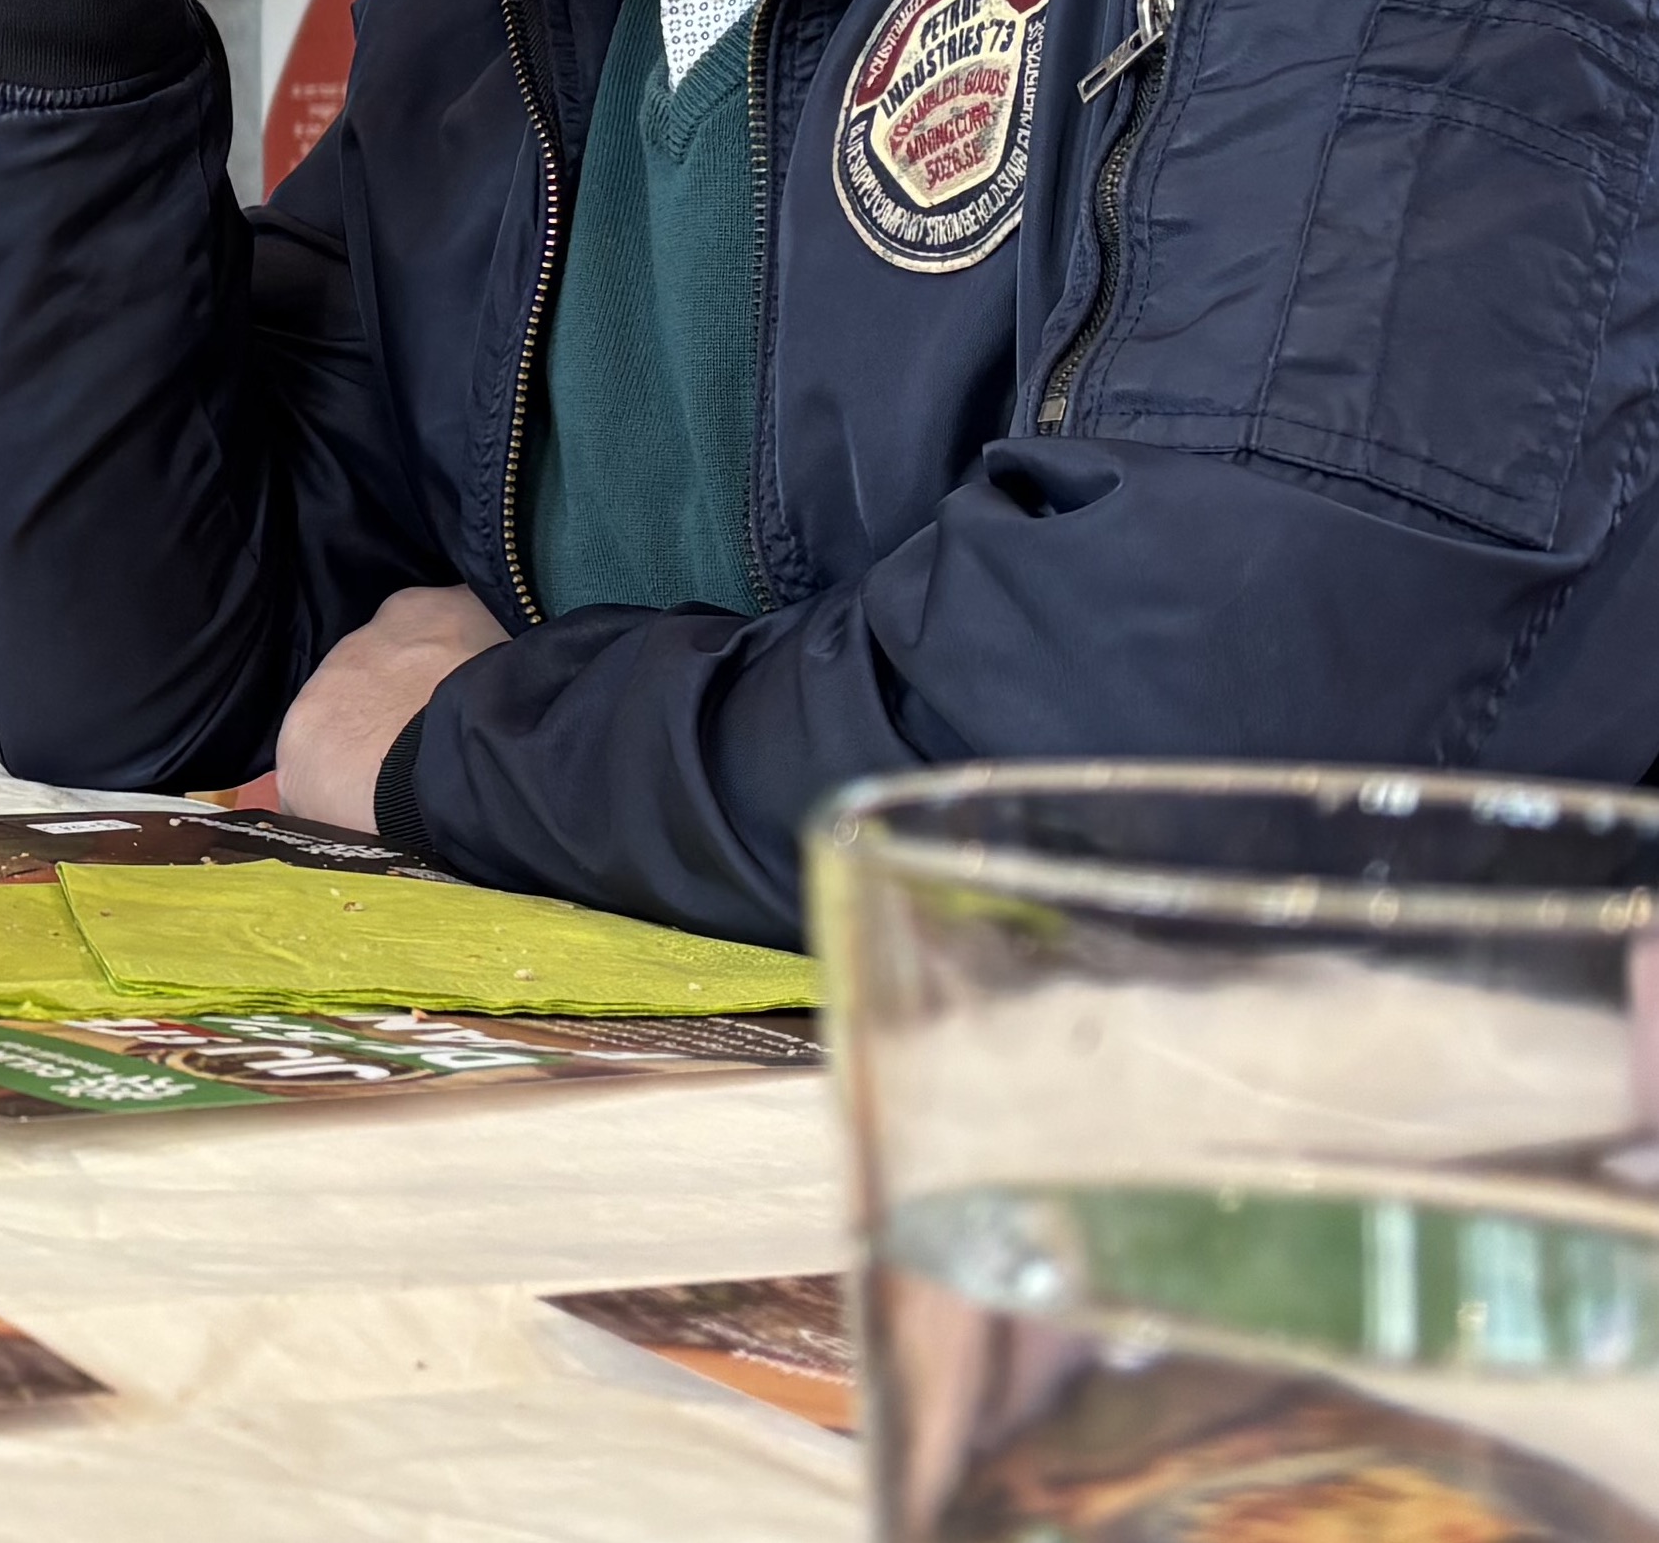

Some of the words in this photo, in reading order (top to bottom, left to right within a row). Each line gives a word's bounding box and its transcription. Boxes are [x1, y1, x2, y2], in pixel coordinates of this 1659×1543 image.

[880, 26, 984, 119] INDUSTRIES
[906, 119, 955, 165] MINING
[194, 1044, 390, 1081] JIJ
